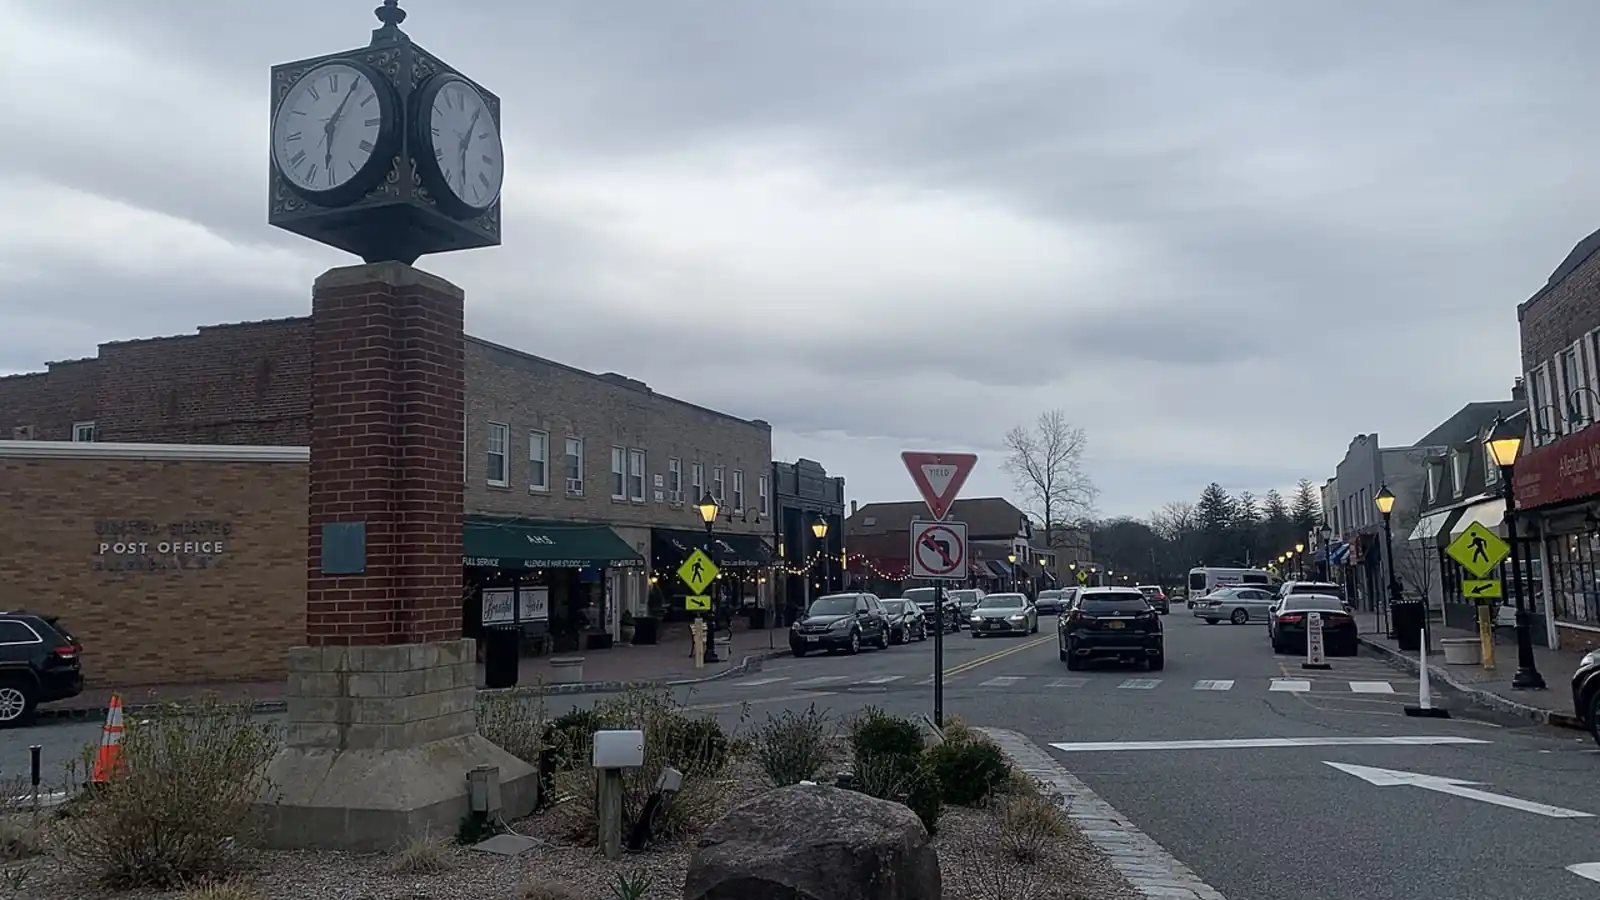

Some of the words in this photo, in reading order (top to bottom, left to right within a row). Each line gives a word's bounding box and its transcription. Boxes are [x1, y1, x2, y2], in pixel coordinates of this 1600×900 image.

[928, 468, 950, 477] YIELD
[99, 541, 148, 555] POST
[157, 540, 224, 554] OFFICE
[462, 556, 476, 567] FULL
[476, 557, 500, 568] SERVICE
